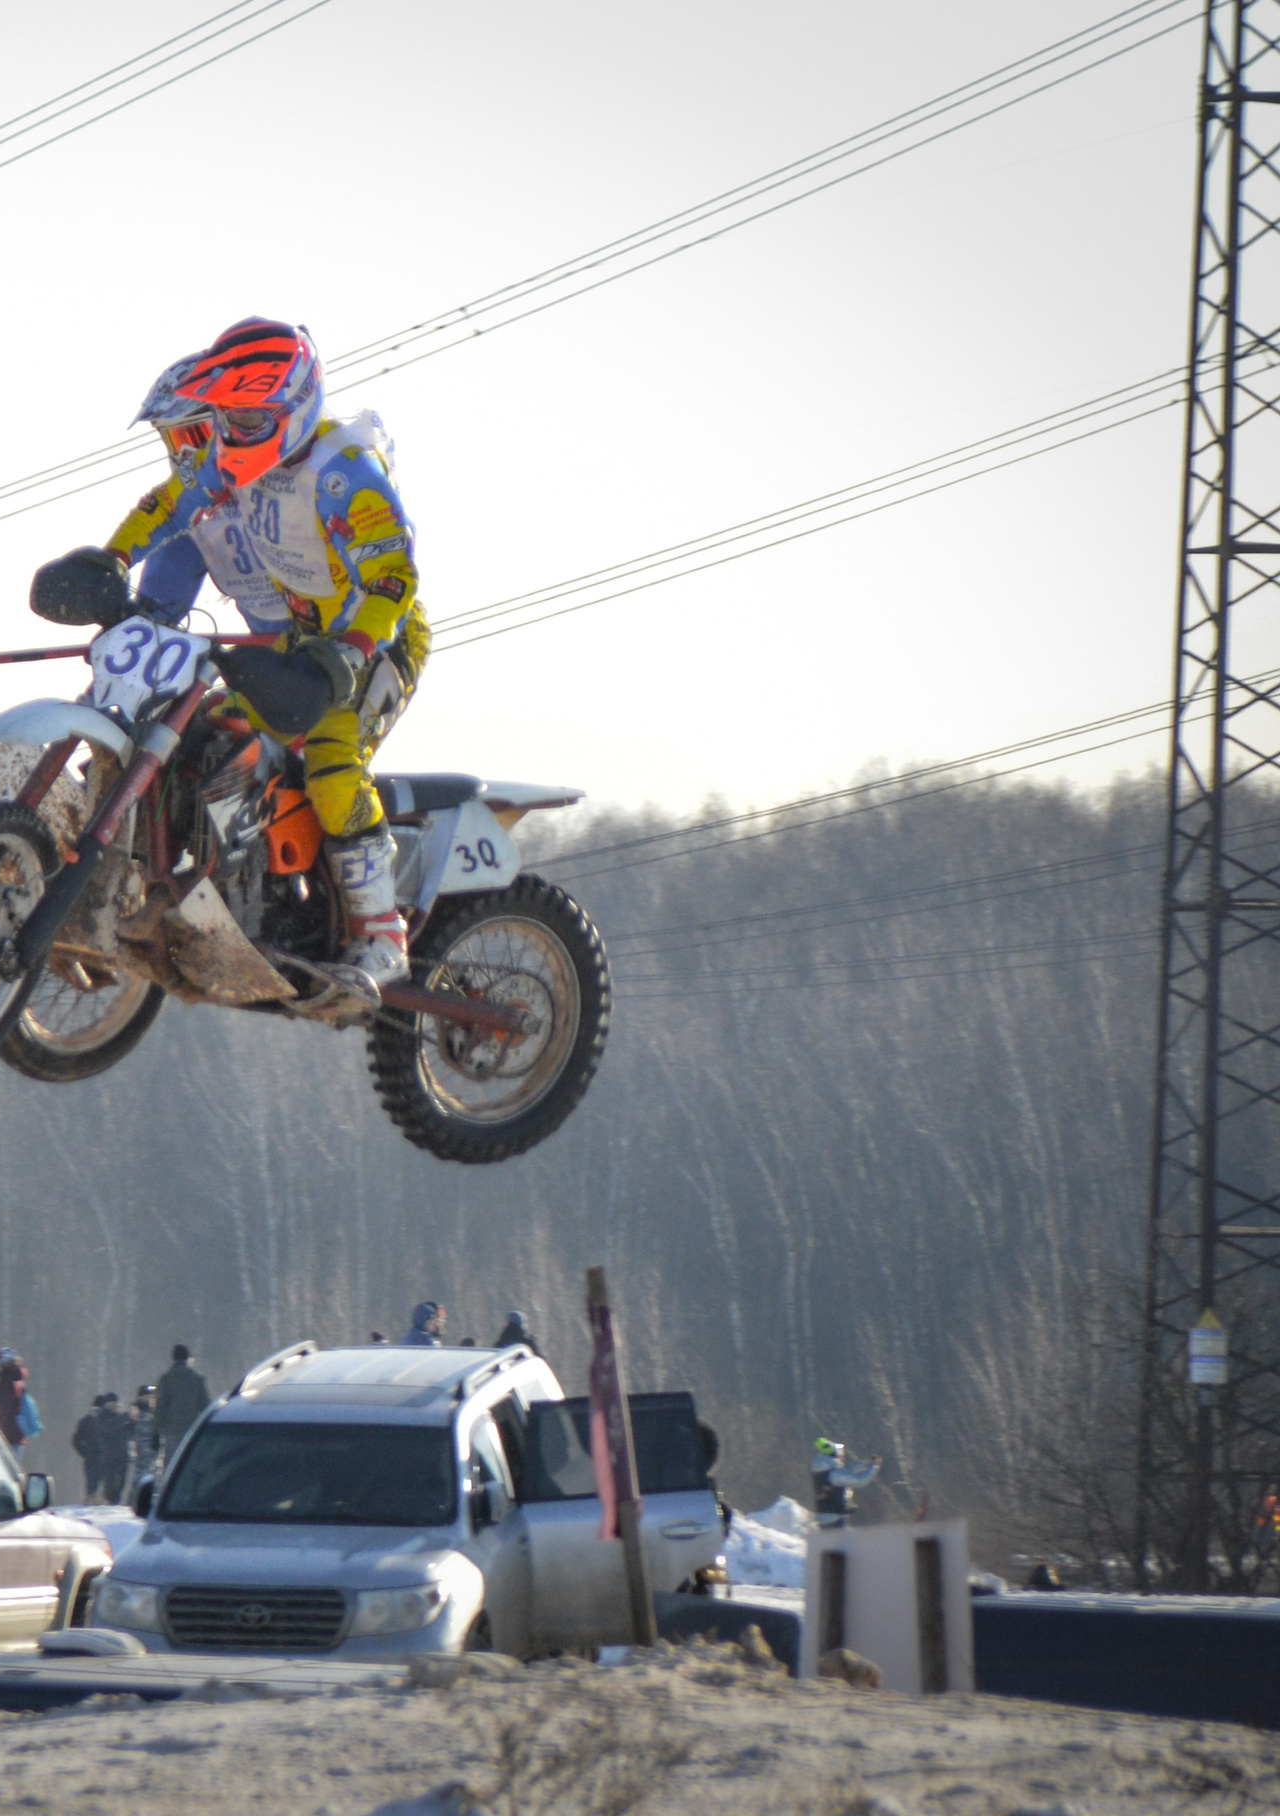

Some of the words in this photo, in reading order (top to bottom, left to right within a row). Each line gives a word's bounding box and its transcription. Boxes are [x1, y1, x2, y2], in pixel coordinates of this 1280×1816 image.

[248, 487, 280, 545] 30
[224, 523, 266, 575] 3
[104, 622, 192, 690] 30
[455, 836, 498, 873] 30
